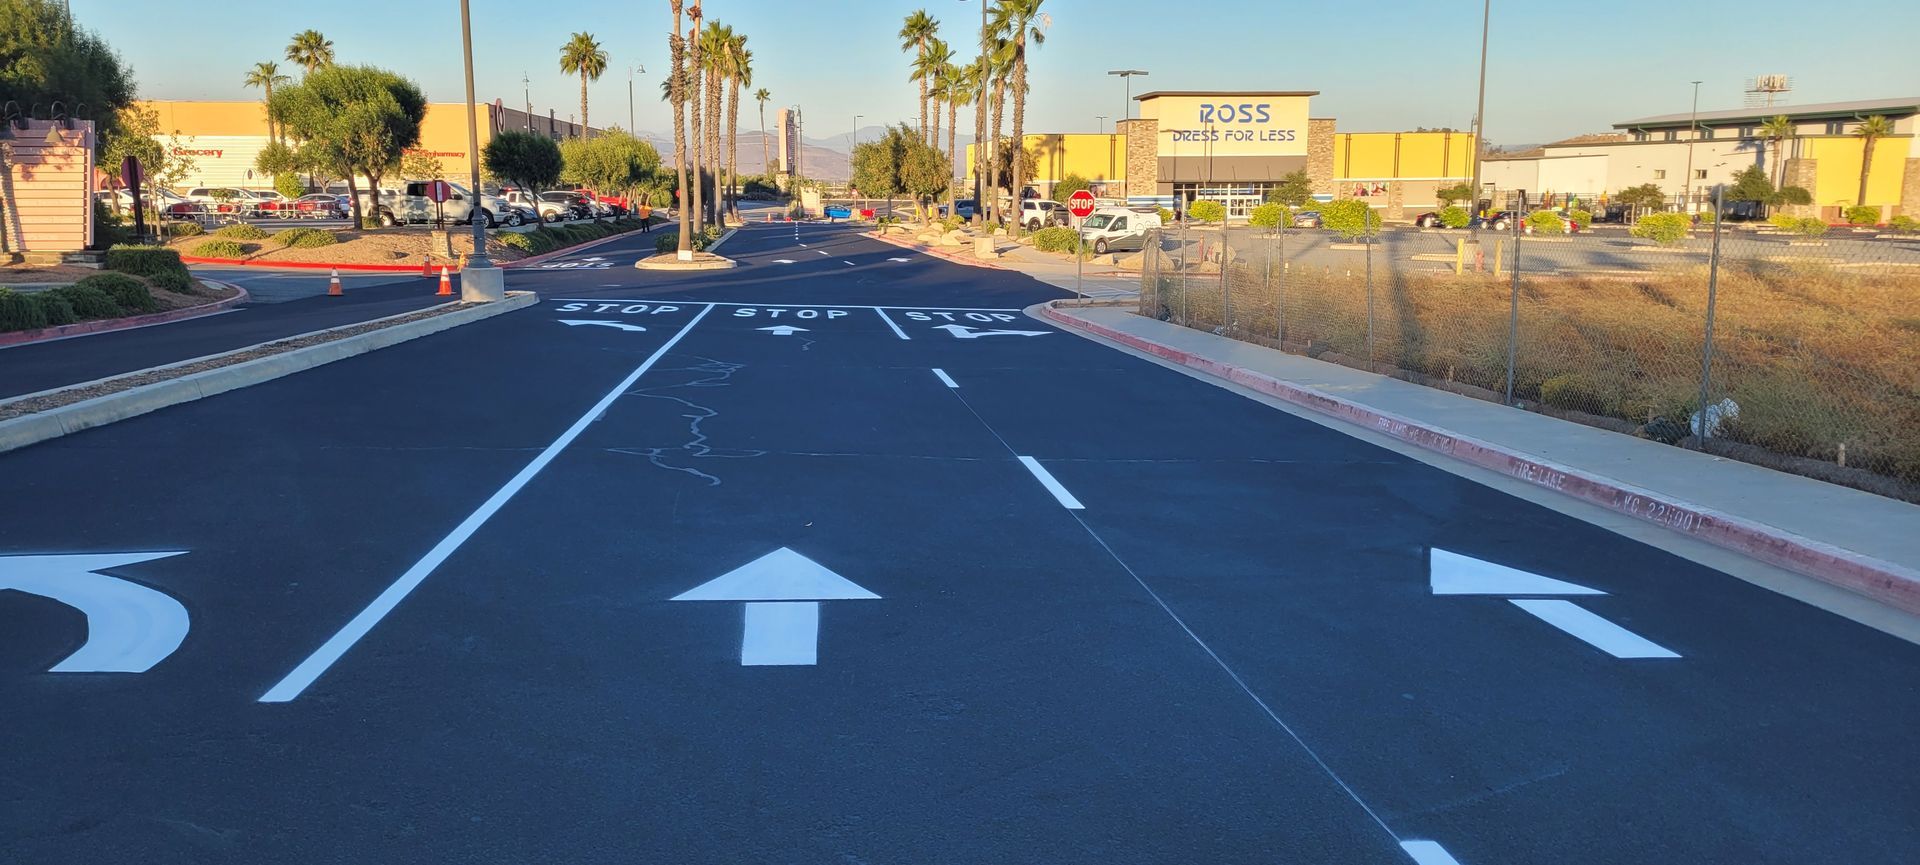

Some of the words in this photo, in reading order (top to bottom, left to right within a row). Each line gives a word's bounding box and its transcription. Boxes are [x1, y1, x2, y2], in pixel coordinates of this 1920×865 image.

[1200, 104, 1271, 123] ROSS
[1173, 130, 1219, 141] DRESS
[1225, 130, 1254, 141] FOR
[1260, 130, 1296, 141] LESS
[1070, 198, 1094, 210] STOP
[555, 302, 679, 315] STOP
[733, 308, 848, 319] STOP
[905, 311, 1016, 322] STOP
[1512, 461, 1536, 481] FIRE
[1538, 469, 1566, 490] LANE
